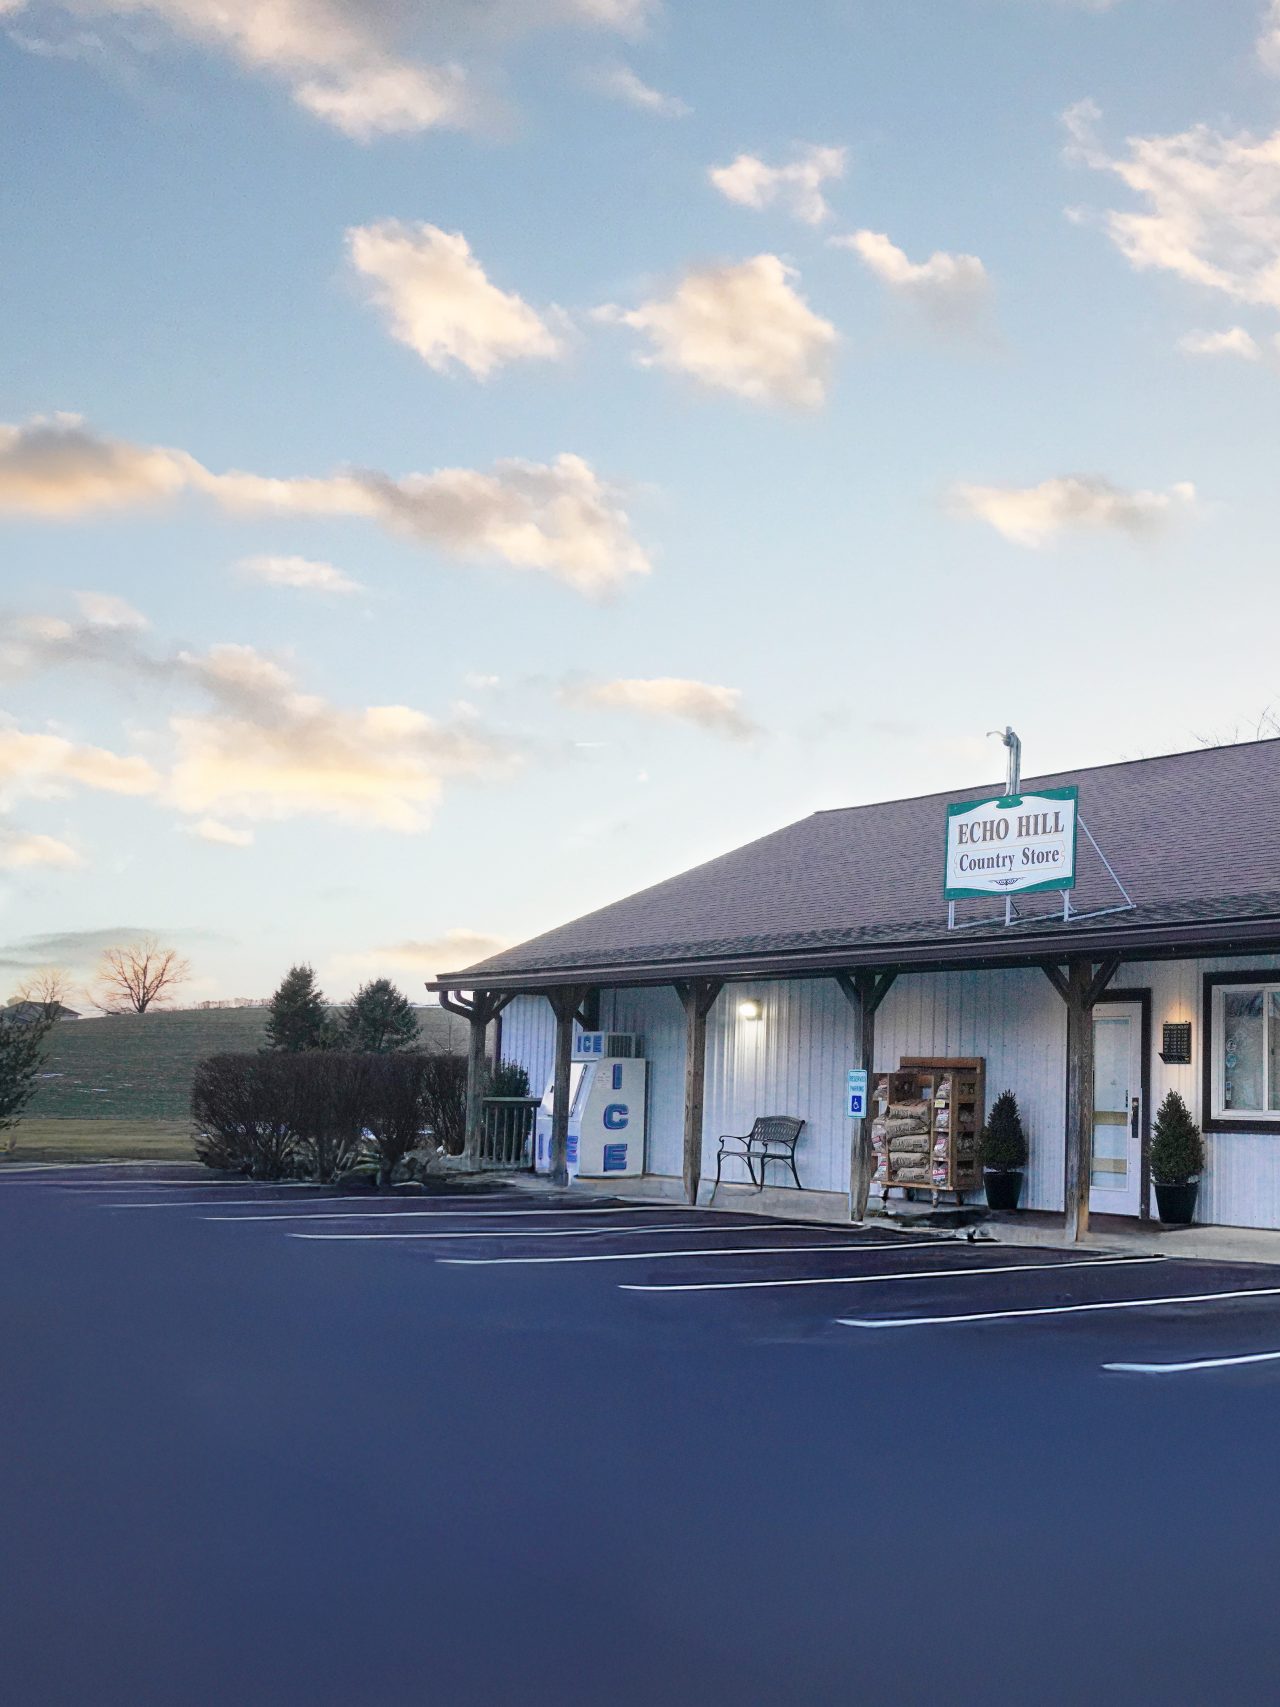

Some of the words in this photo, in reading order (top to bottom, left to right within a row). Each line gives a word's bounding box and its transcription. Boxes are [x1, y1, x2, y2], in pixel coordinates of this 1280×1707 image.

[958, 818, 1010, 845] ECHO
[1016, 811, 1064, 838] HILL
[959, 854, 1015, 872] Country
[1021, 847, 1060, 865] Store
[577, 1034, 603, 1053] ICE
[603, 1063, 629, 1172] ICE
[538, 1133, 579, 1163] IE
